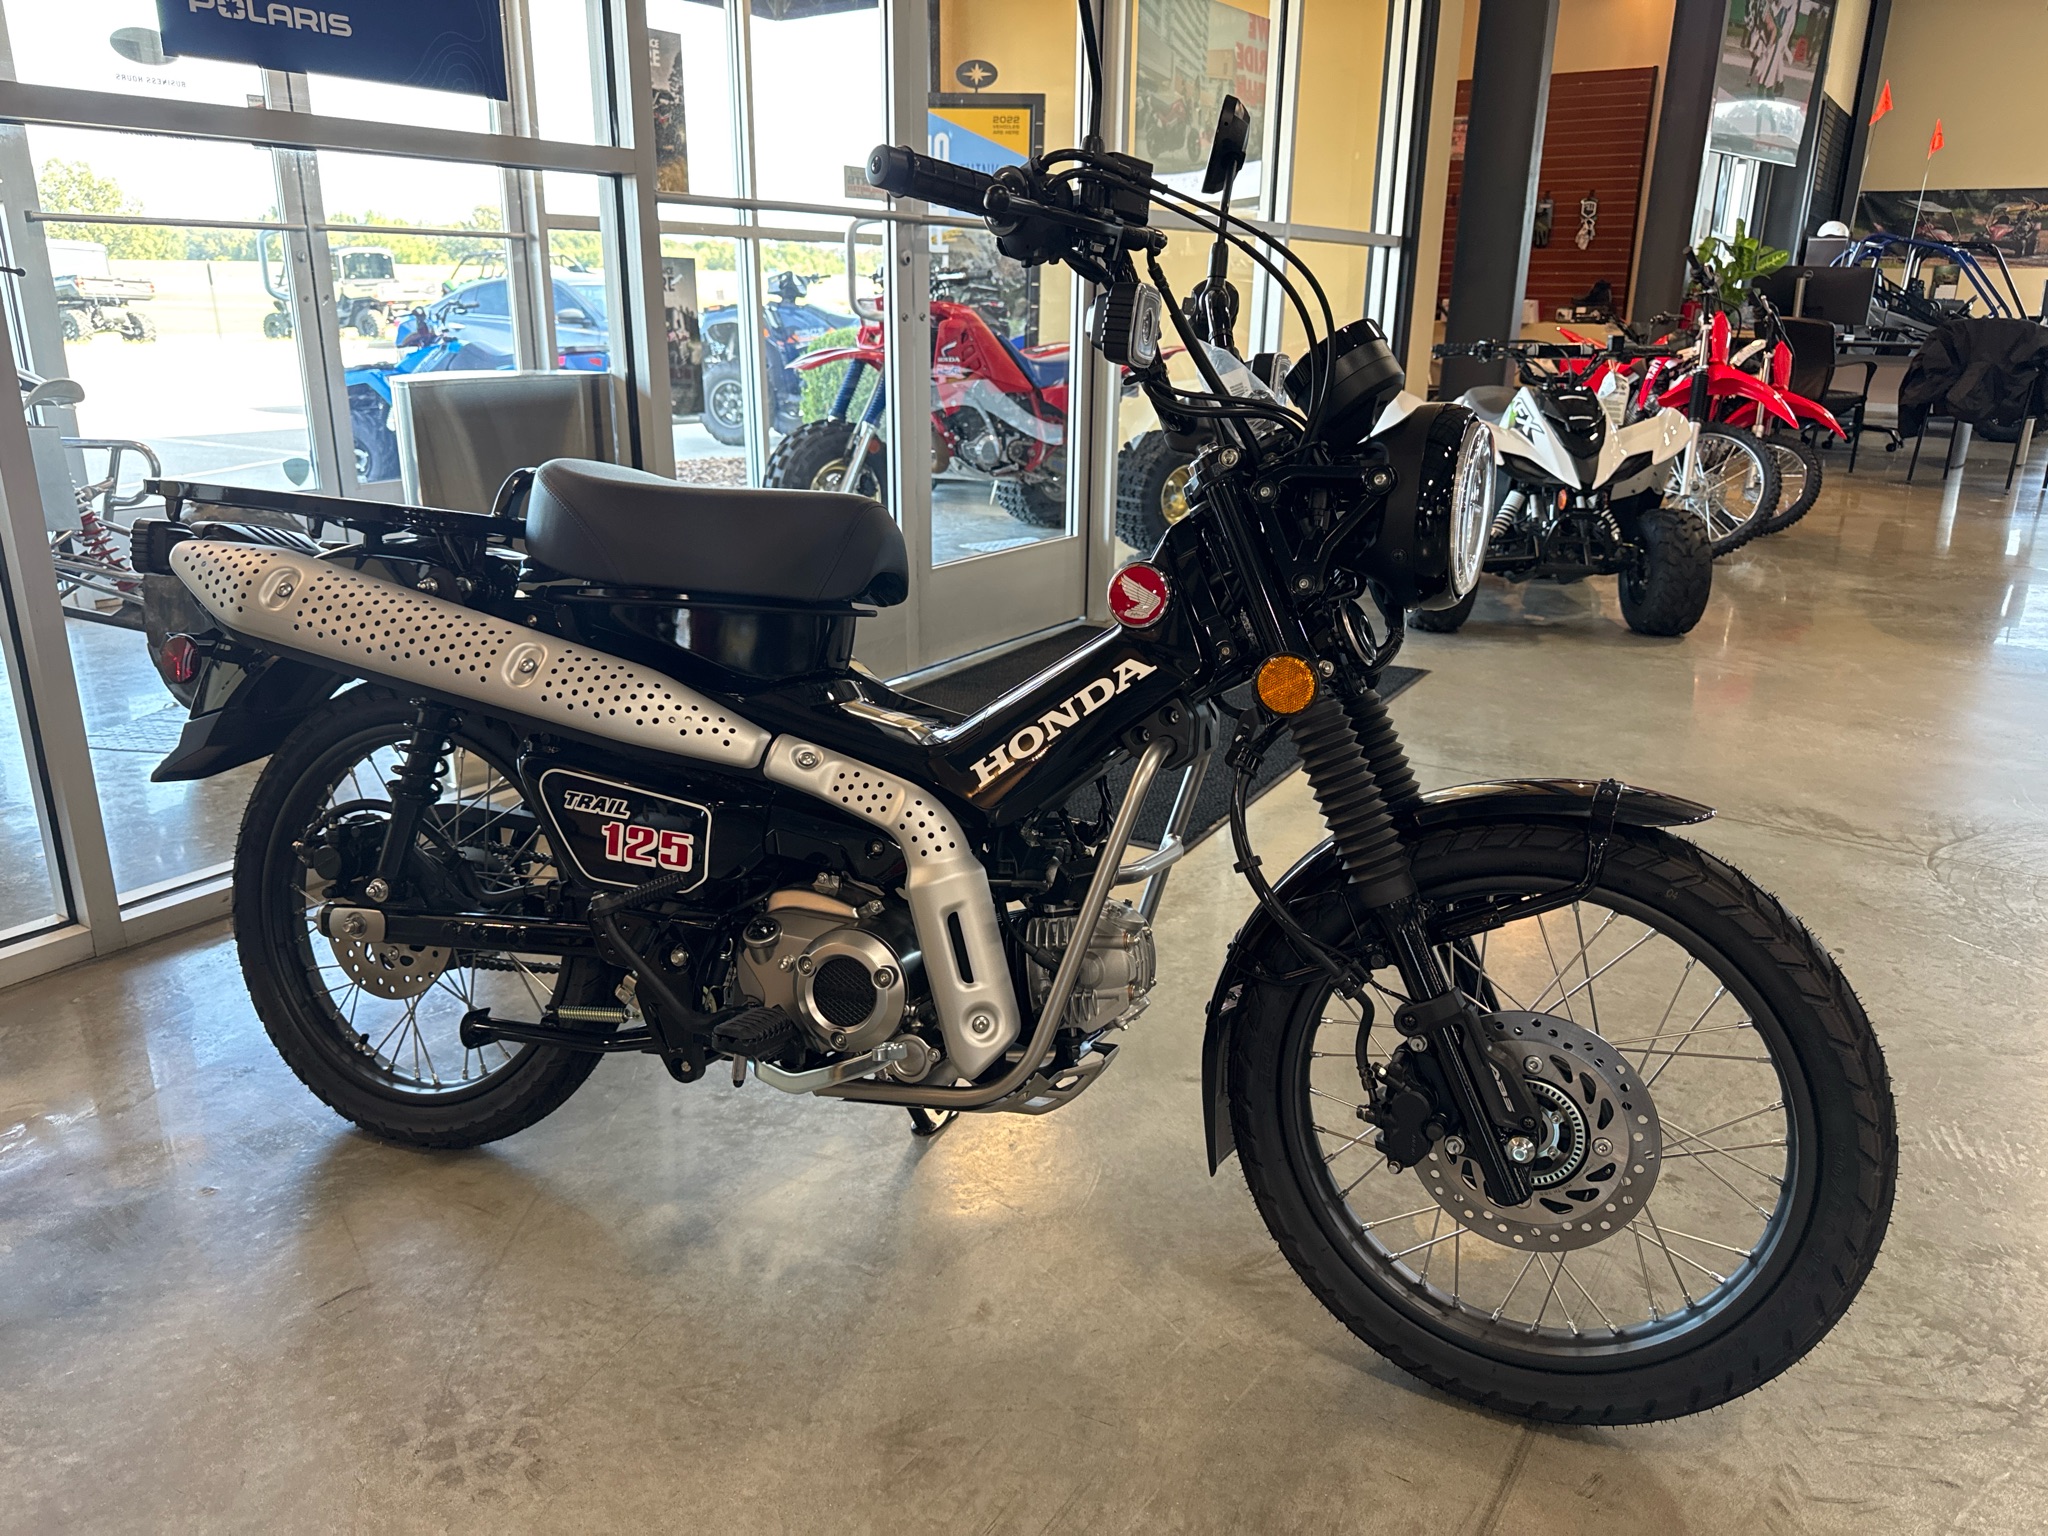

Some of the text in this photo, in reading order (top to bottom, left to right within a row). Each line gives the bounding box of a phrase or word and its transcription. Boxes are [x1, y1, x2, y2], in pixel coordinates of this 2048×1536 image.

[188, 0, 353, 38] POLARIS
[992, 115, 1020, 124] 2022
[969, 658, 1158, 788] HONDA
[564, 790, 631, 820] TRAIL
[601, 821, 694, 873] 125
